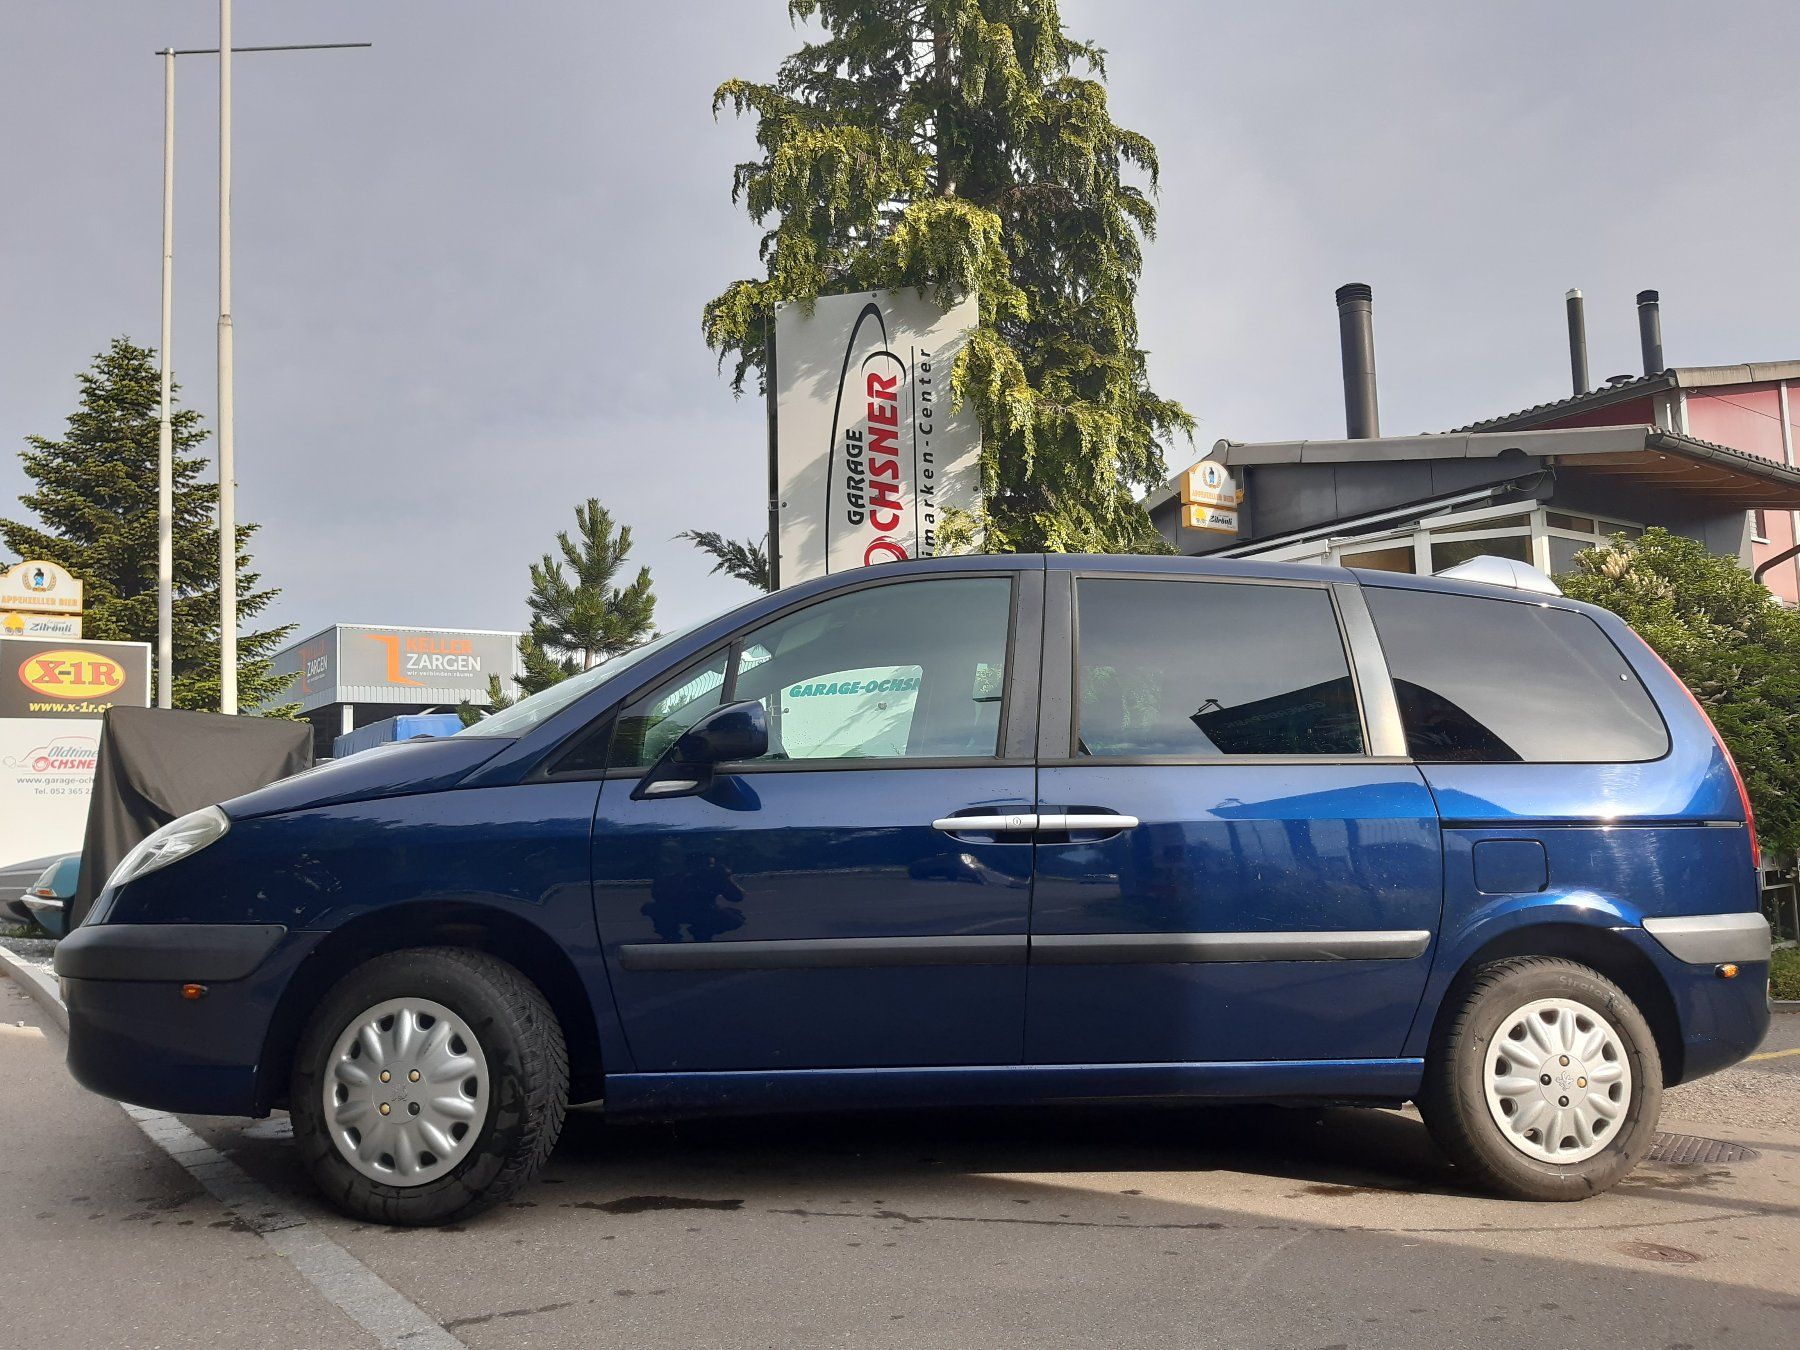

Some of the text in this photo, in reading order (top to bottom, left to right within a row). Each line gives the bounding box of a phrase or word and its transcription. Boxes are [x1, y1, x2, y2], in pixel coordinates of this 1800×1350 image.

[846, 428, 866, 526] GARAGE
[59, 596, 78, 607] BIER
[32, 660, 119, 686] X-1R
[307, 654, 328, 677] ZARGEN
[406, 653, 481, 672] ZARGEN
